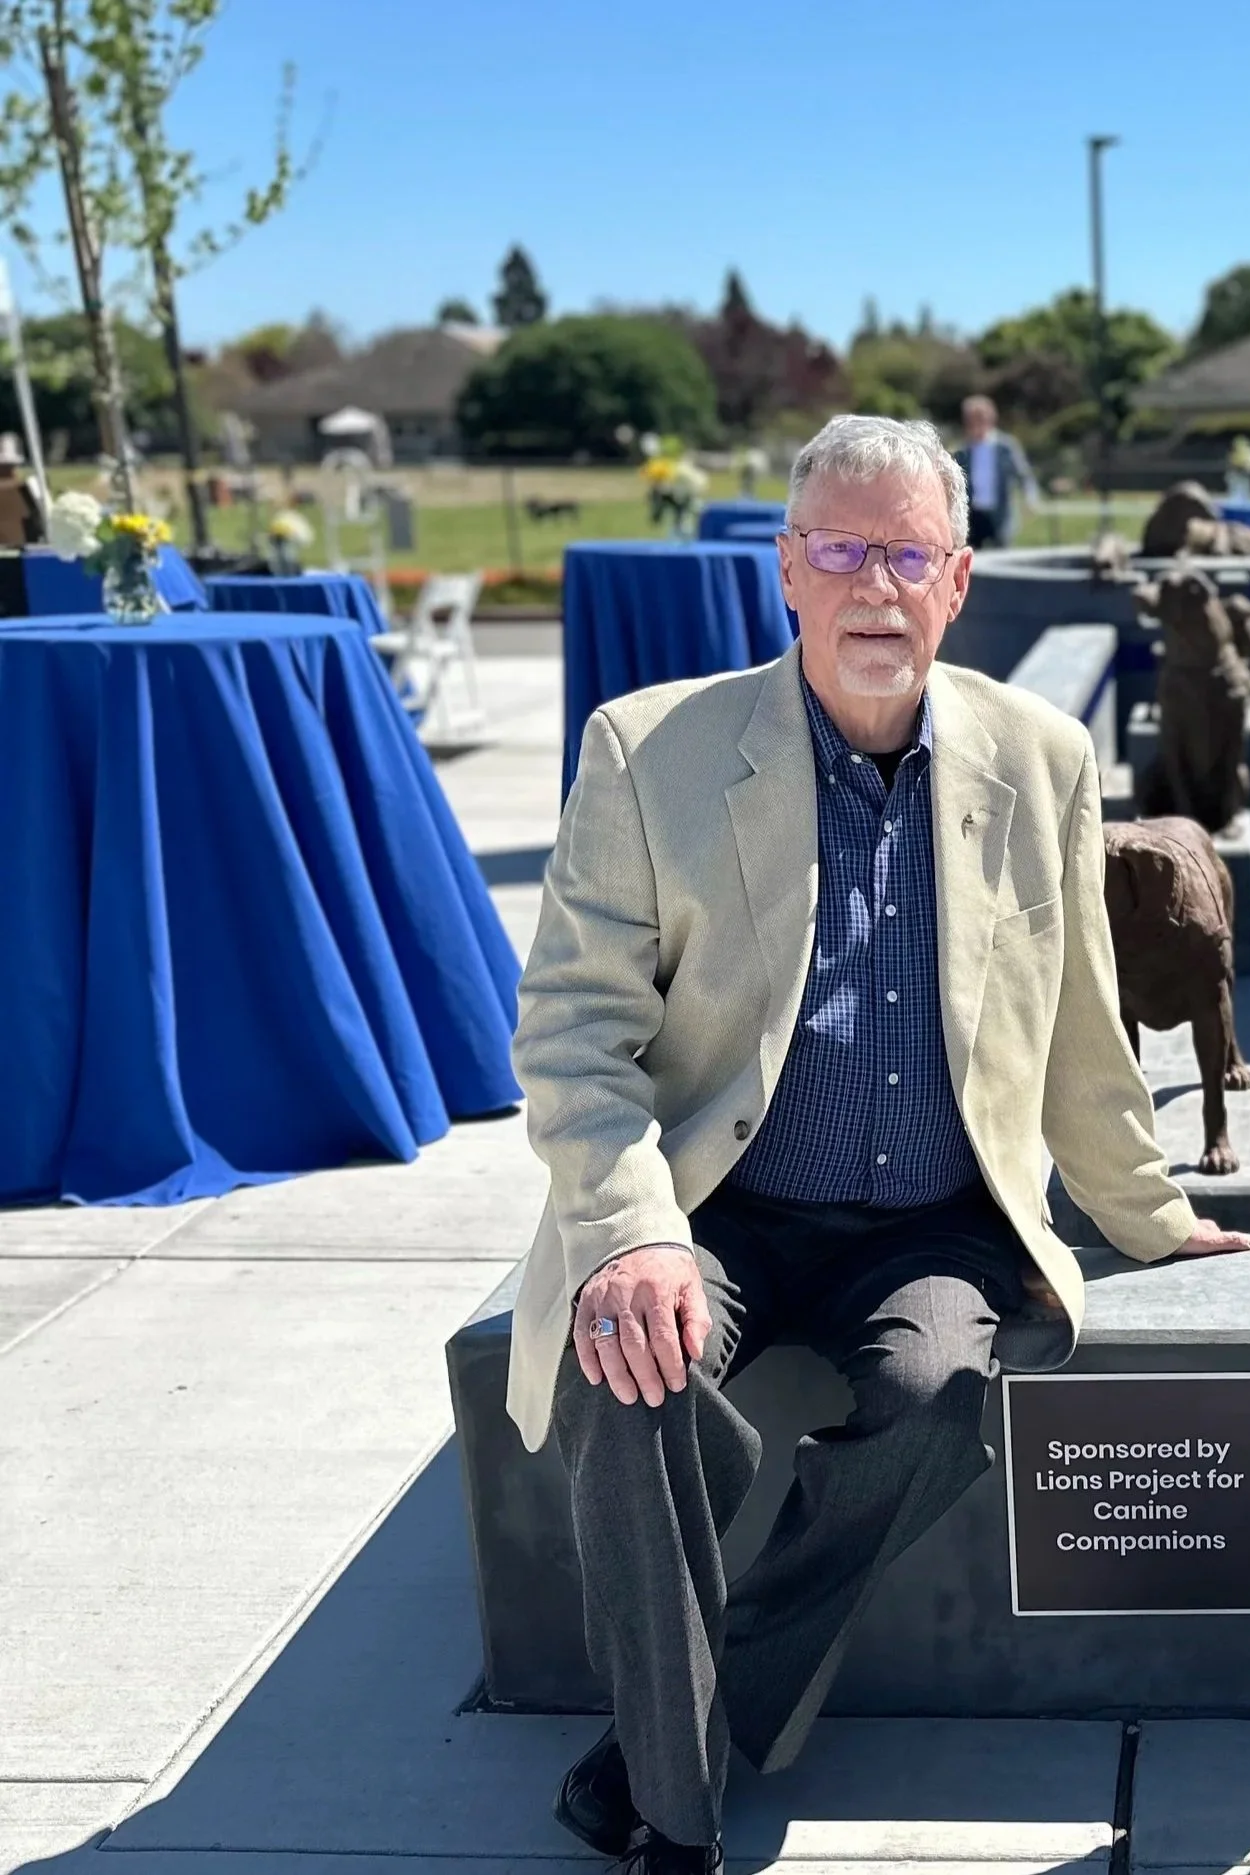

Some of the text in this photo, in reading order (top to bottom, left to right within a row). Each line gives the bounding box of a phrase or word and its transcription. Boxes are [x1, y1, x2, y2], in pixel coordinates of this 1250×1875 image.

[1048, 1438, 1231, 1466] Sponsored by
[1036, 1468, 1245, 1496] Lions Project for
[1093, 1499, 1188, 1520] Canine
[1056, 1529, 1226, 1556] Companions
